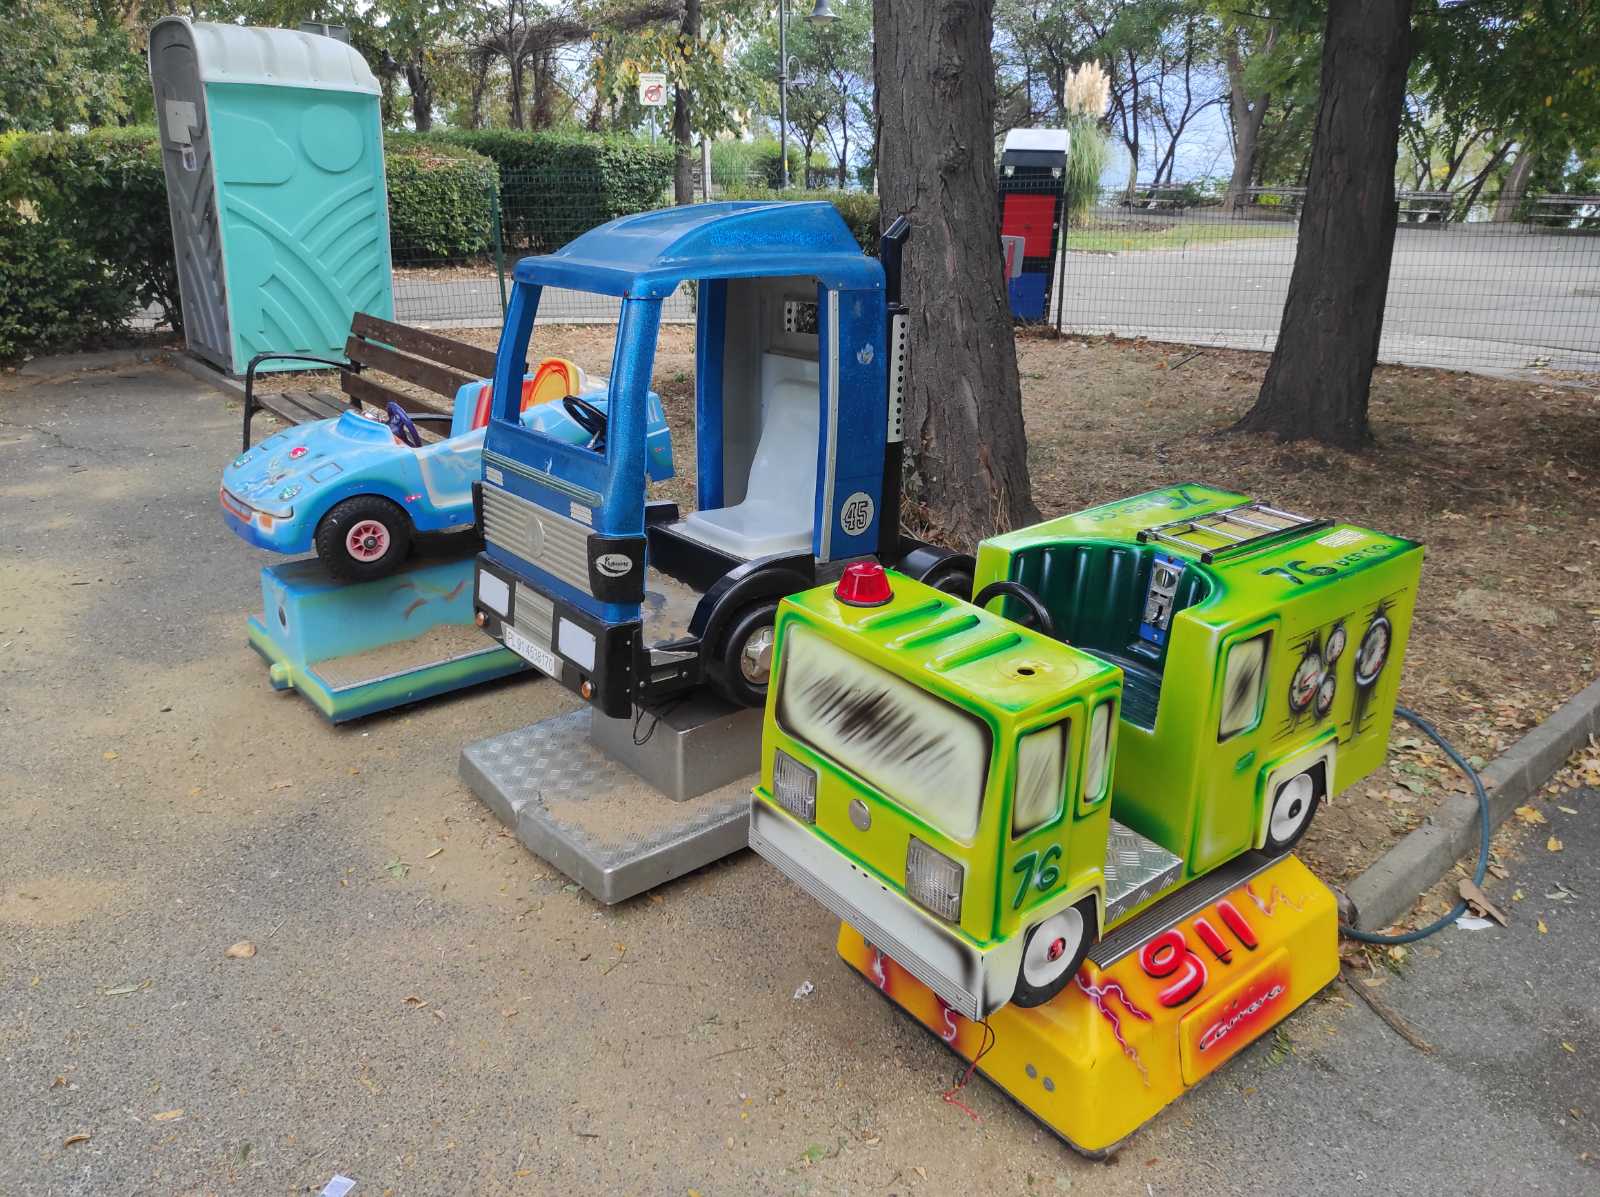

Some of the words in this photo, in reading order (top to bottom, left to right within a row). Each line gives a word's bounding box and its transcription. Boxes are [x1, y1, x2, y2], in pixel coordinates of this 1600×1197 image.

[844, 500, 870, 531] 45
[1260, 560, 1338, 585] 76
[1012, 843, 1063, 910] 76
[1139, 899, 1259, 1008] 911
[1199, 984, 1285, 1050] Carrera
